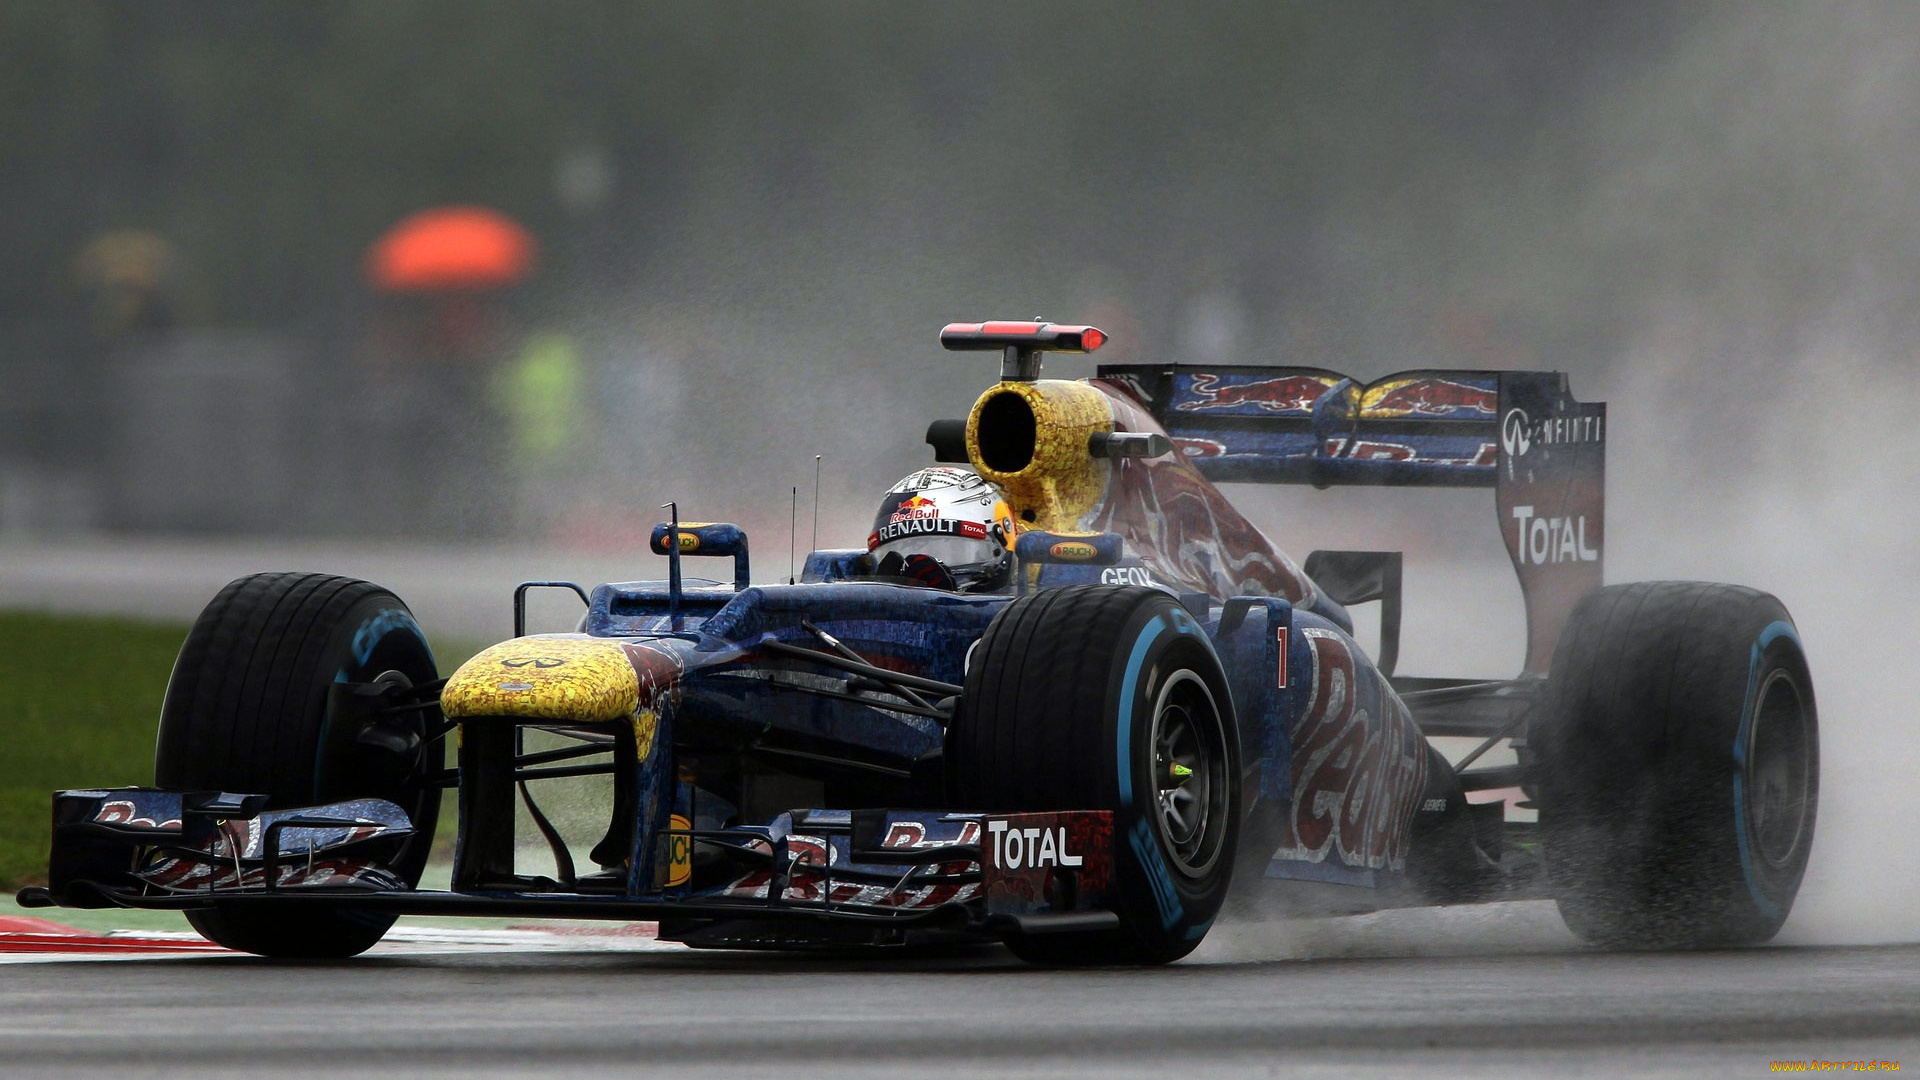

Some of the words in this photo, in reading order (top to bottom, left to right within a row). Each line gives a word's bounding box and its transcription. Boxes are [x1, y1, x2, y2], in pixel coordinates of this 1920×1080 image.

[890, 509, 915, 524] Red
[915, 509, 939, 519] Bull
[879, 519, 958, 541] RENAULT
[963, 524, 985, 534] TOTAL
[1513, 505, 1597, 564] TOTAL
[678, 538, 695, 547] UCH
[1062, 547, 1091, 556] RAUCH
[1277, 626, 1287, 689] 1
[988, 821, 1083, 869] TOTAL
